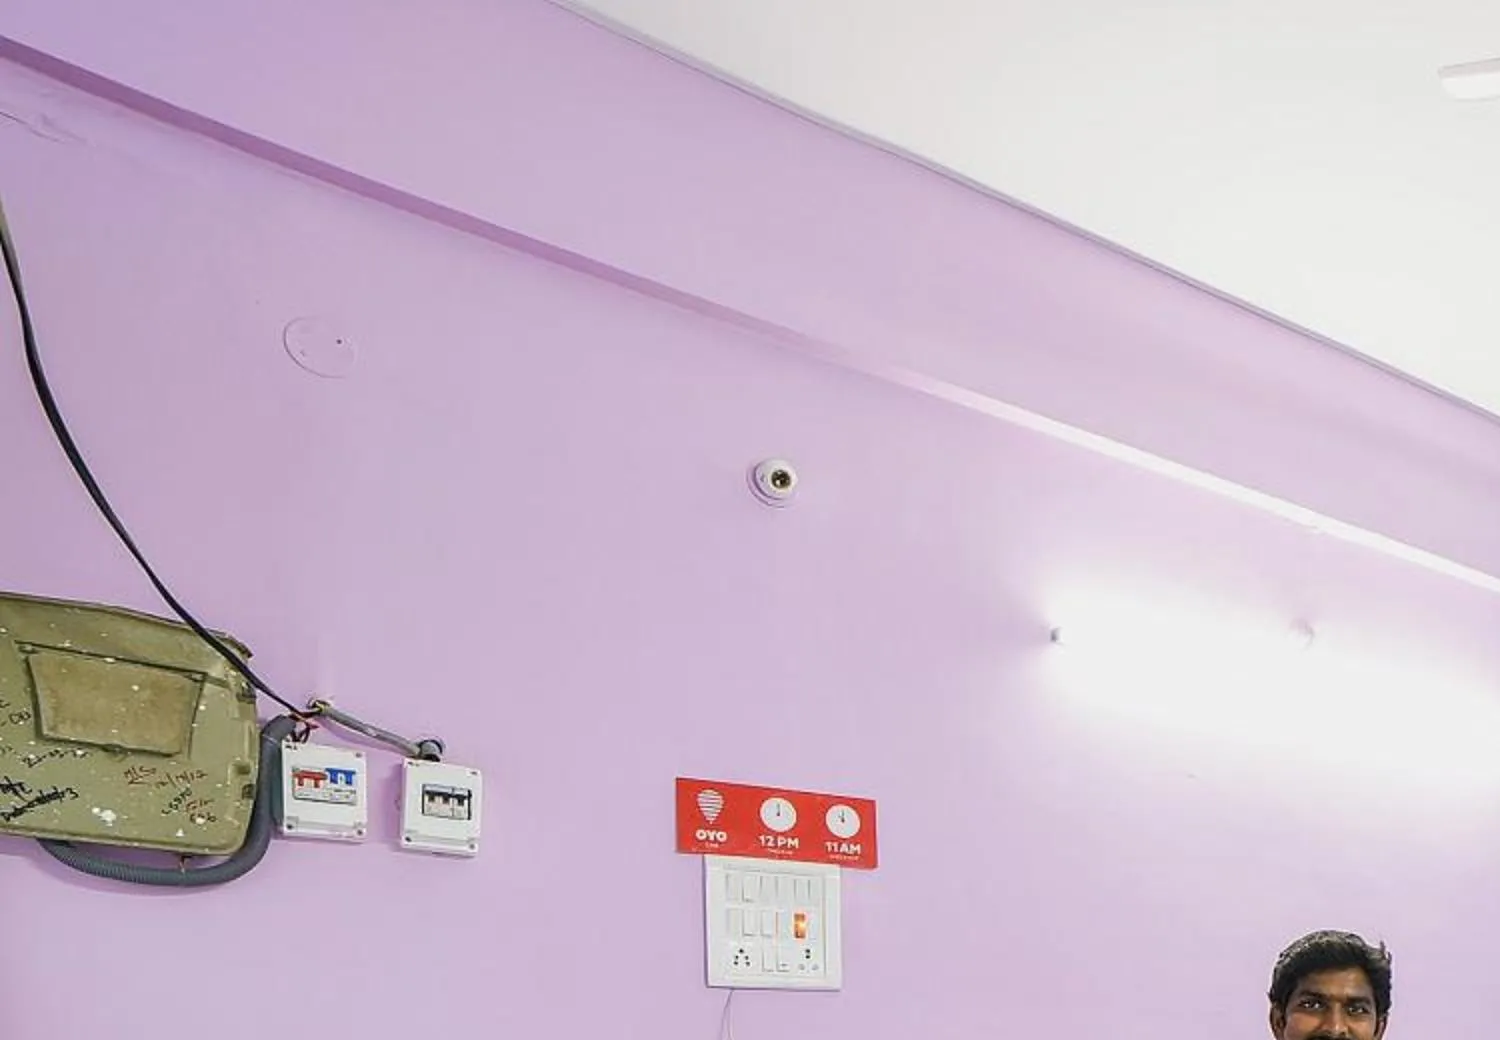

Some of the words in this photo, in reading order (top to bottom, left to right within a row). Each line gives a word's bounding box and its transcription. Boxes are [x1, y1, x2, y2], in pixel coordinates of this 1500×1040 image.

[696, 829, 728, 843] OYO
[759, 835, 775, 848] 12
[777, 837, 799, 849] PM
[825, 841, 838, 853] 11
[839, 842, 862, 855] AM
